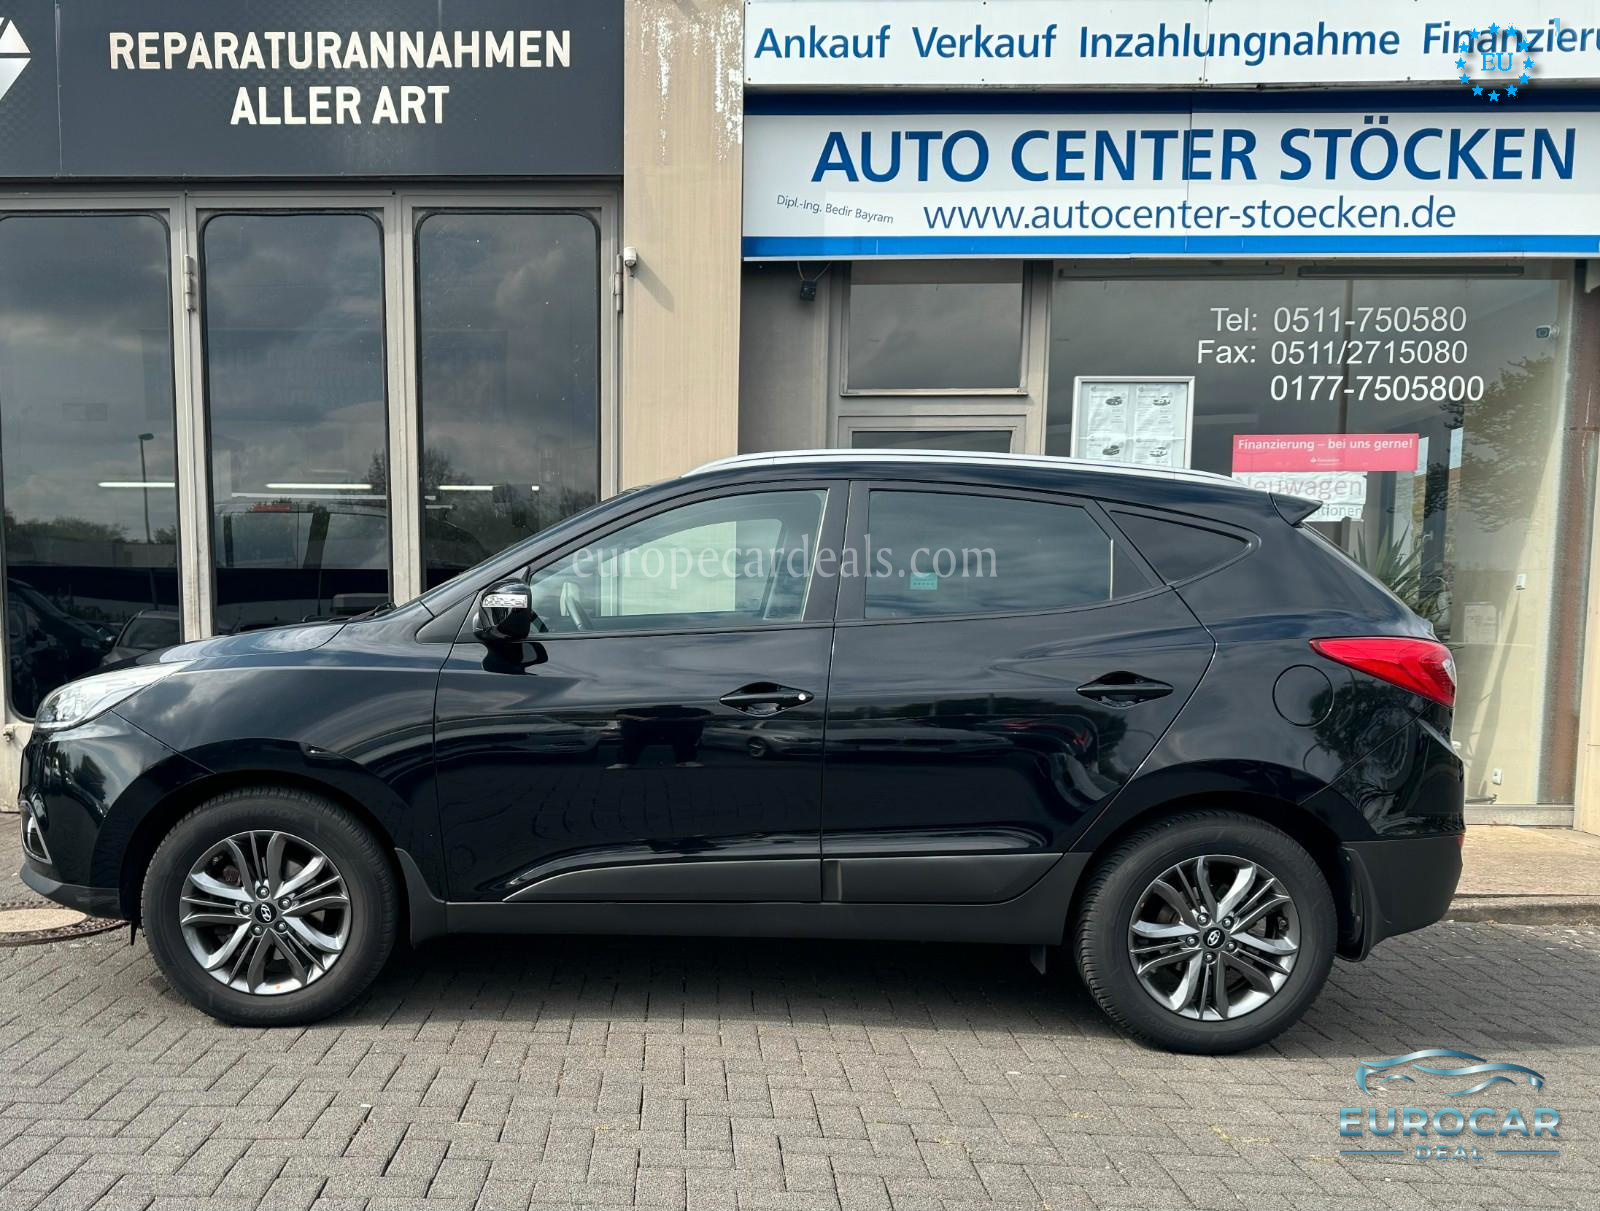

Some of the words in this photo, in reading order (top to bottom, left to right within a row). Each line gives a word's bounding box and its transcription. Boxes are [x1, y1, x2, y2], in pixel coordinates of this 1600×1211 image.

[110, 30, 570, 69] REPARATURANNAHMEN
[754, 25, 890, 58] Ankauf
[912, 24, 1057, 58] Verkauf
[1080, 22, 1399, 66] Inzahlungnahme
[1424, 20, 1600, 54] Finanzier
[231, 86, 361, 124] ALLER
[372, 86, 449, 124] ART
[811, 130, 988, 182] AUTO
[1012, 129, 1257, 181] CENTER
[1280, 115, 1575, 181] STÖCKEN
[777, 195, 821, 214] Dipl.-Ing.
[825, 203, 852, 217] Bedir
[855, 208, 894, 224] Bayram
[924, 195, 1455, 228] www.autocenter-stoecken.de
[1211, 307, 1257, 332] Tel:
[1274, 306, 1467, 332] 0511-750580
[1197, 339, 1256, 364] Fax:
[1271, 340, 1468, 364] 0511/2715080
[1270, 375, 1484, 401] 0177-7505800
[1238, 439, 1315, 451] Finanzierung
[1328, 439, 1346, 449] bei
[1350, 440, 1371, 449] uns
[1374, 439, 1413, 451] gerne!
